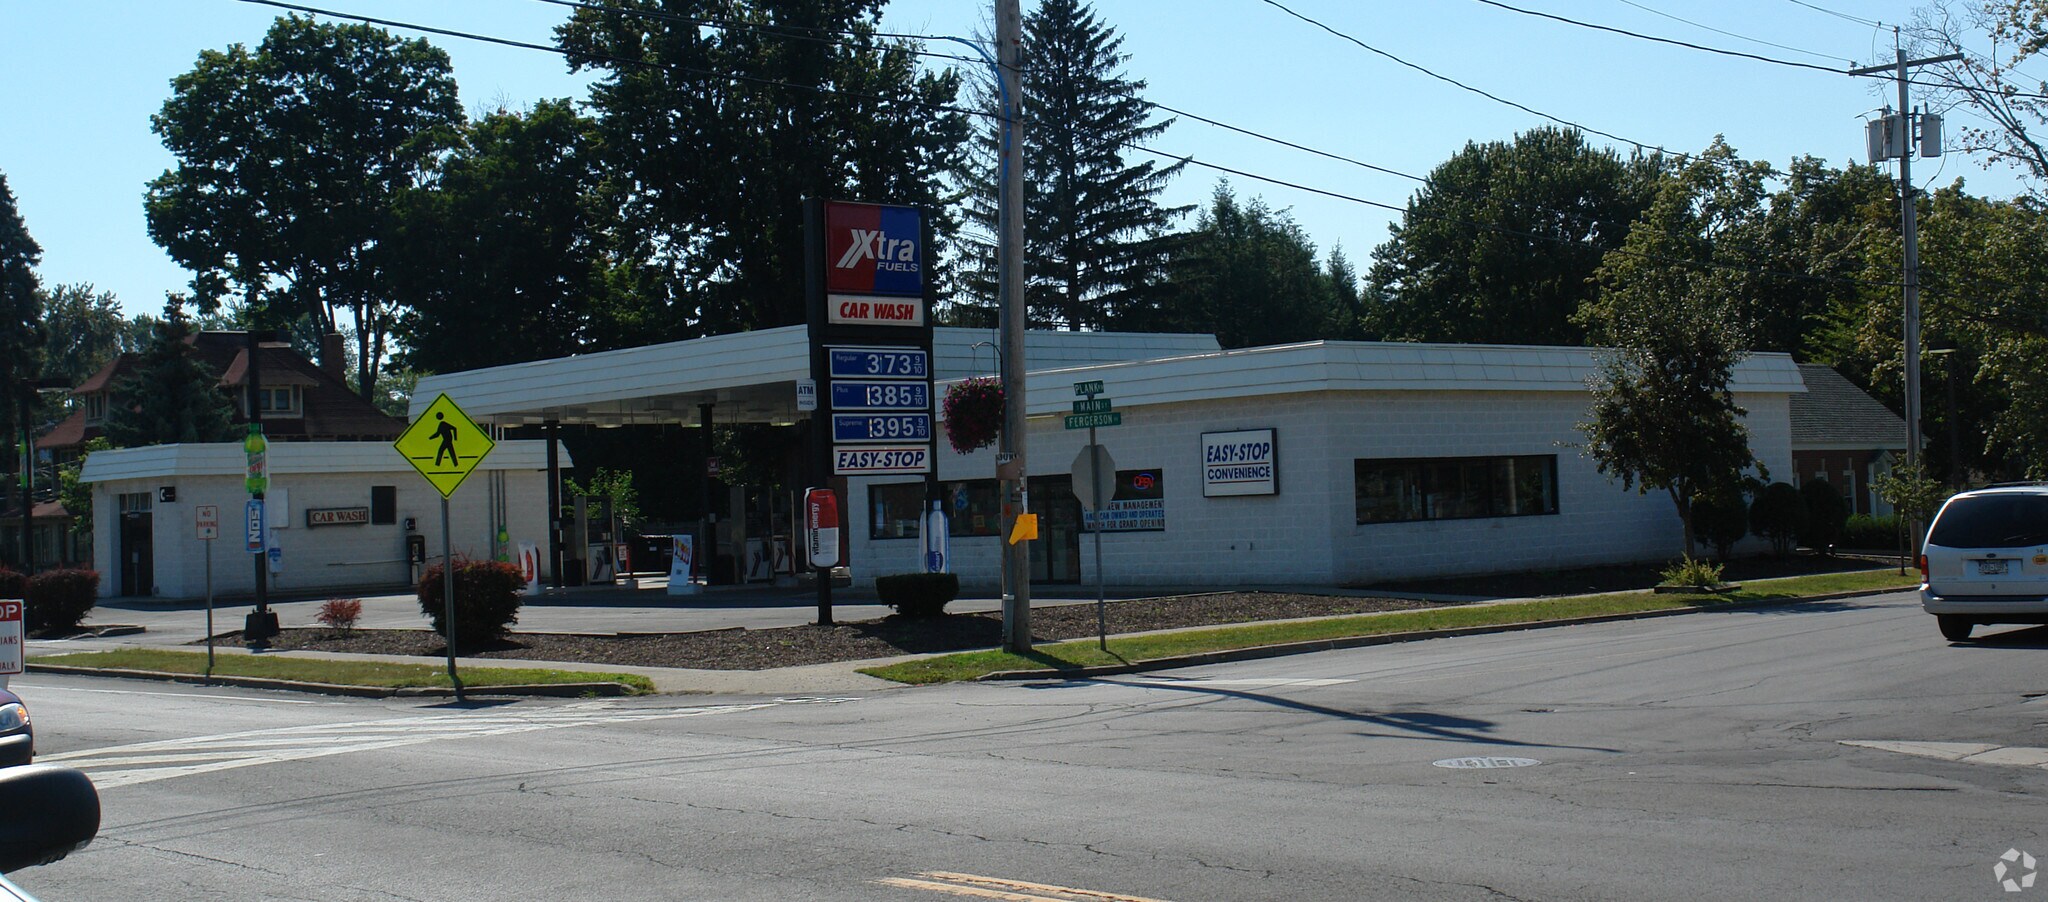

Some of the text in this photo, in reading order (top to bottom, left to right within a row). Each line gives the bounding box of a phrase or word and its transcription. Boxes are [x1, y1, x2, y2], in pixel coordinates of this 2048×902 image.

[835, 228, 915, 269] Xtra
[876, 261, 919, 272] FUELS
[839, 302, 914, 321] CAR WASH
[836, 354, 858, 362] Regular
[867, 354, 911, 374] 373
[798, 386, 814, 395] ATM
[1074, 382, 1099, 394] PLANK
[1080, 401, 1101, 411] MAIN
[838, 419, 862, 427] Supreme
[1069, 414, 1113, 428] FERGERSON
[838, 451, 925, 468] EASY-STOP
[1206, 442, 1270, 463] EASY-STOP
[1207, 466, 1270, 480] CONVENIENCE
[1134, 475, 1154, 489] OPEN
[313, 510, 366, 523] CAR WASH
[1111, 511, 1128, 520] OWNED
[249, 509, 260, 543] NOS
[1107, 520, 1117, 529] FOR
[1119, 519, 1138, 529] GRAND
